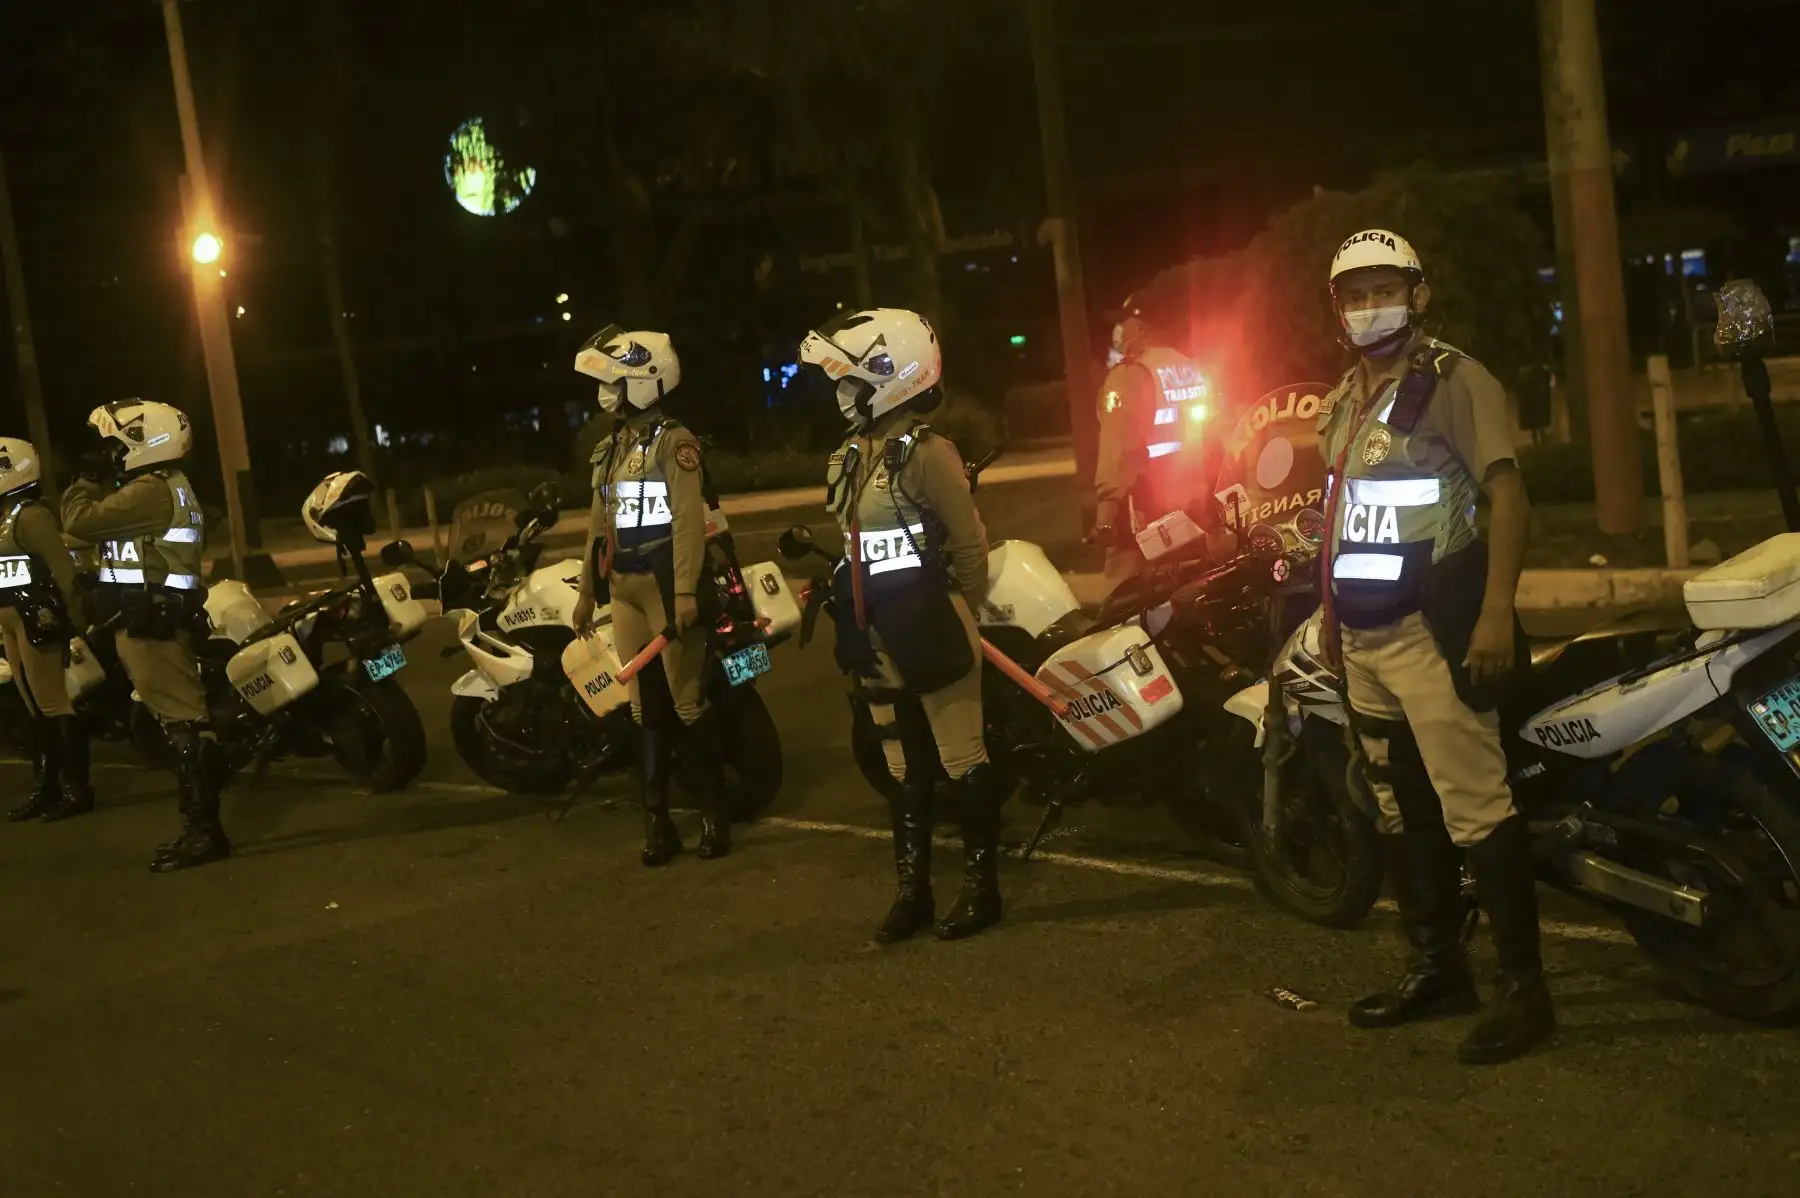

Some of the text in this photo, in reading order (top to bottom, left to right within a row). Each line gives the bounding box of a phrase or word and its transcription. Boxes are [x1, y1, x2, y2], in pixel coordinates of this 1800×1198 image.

[1336, 232, 1396, 262] POLICIA
[241, 672, 275, 699] POLICIA
[584, 671, 614, 698] POLICIA
[1534, 718, 1602, 748] POLICIA
